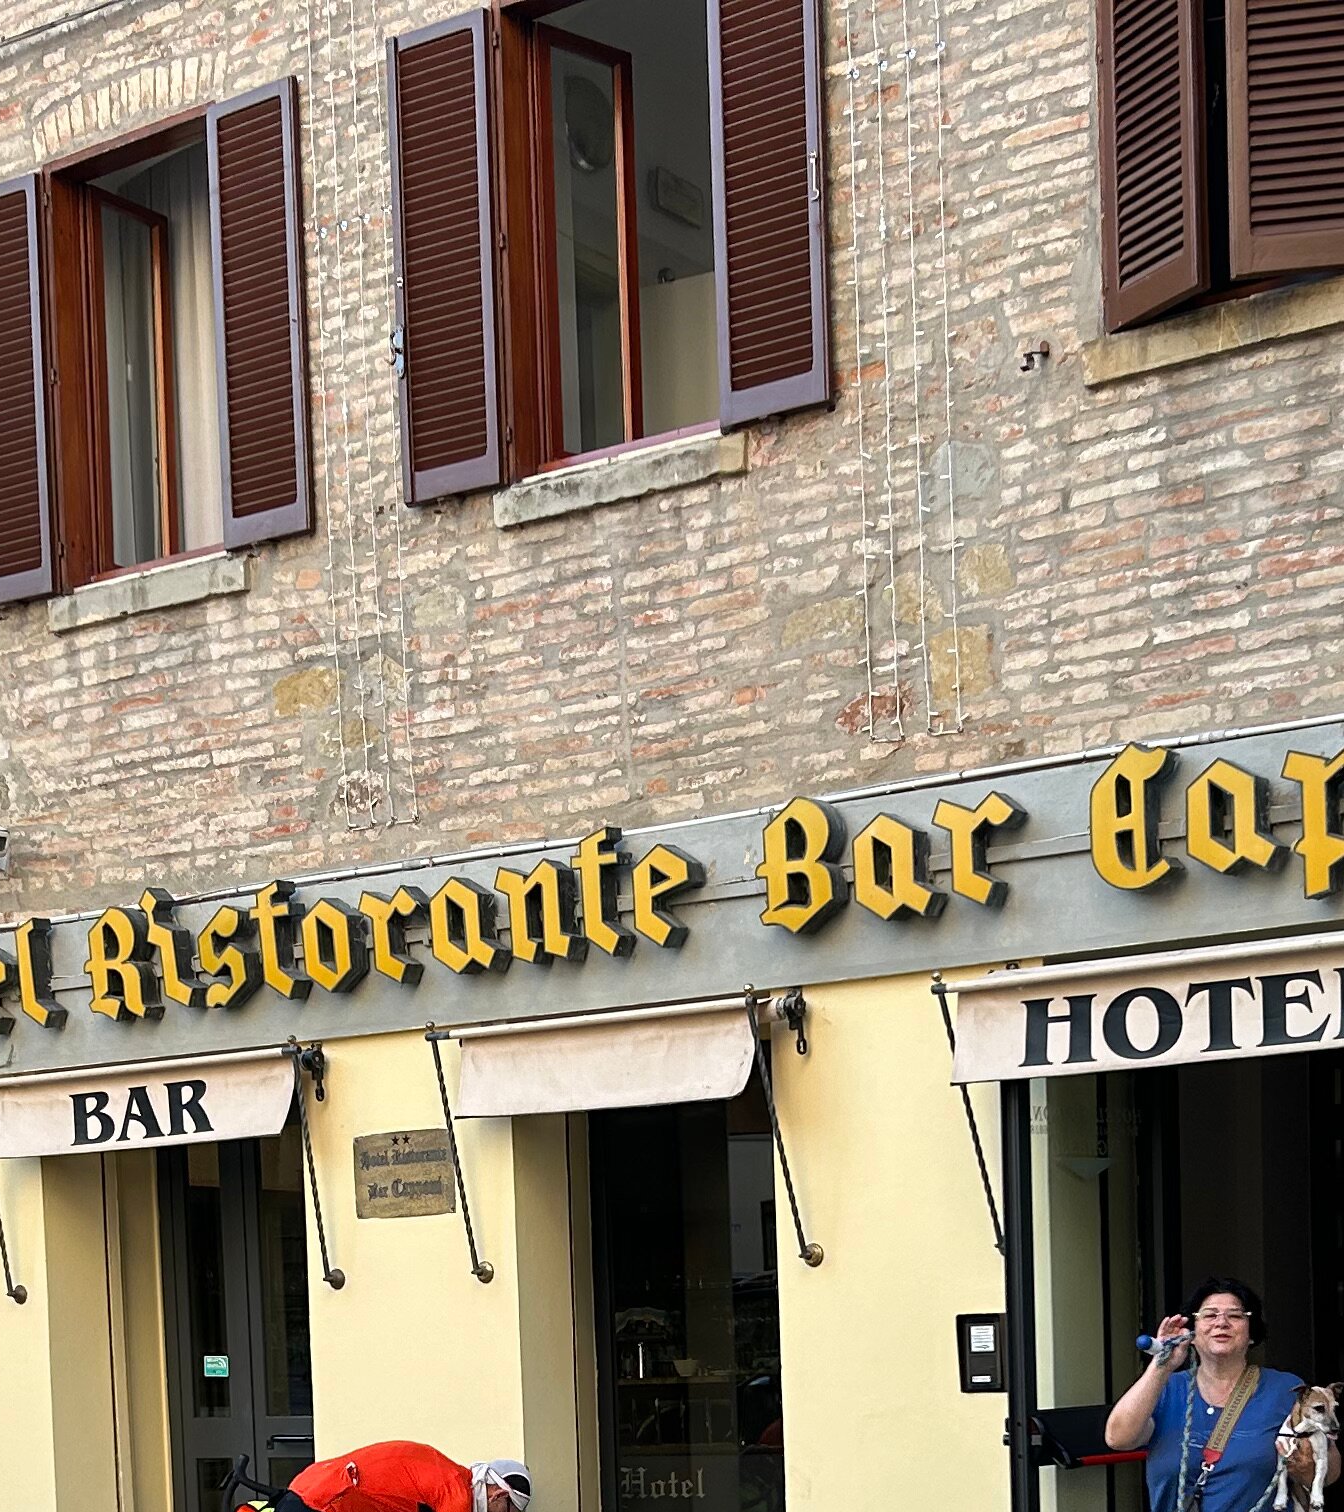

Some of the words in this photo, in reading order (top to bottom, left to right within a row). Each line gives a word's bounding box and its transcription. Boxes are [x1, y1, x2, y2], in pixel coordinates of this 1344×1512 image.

[84, 827, 706, 1021] Ristorante
[756, 790, 1028, 934] Bar
[69, 1079, 214, 1146] BAR
[620, 1466, 706, 1498] Hotel
